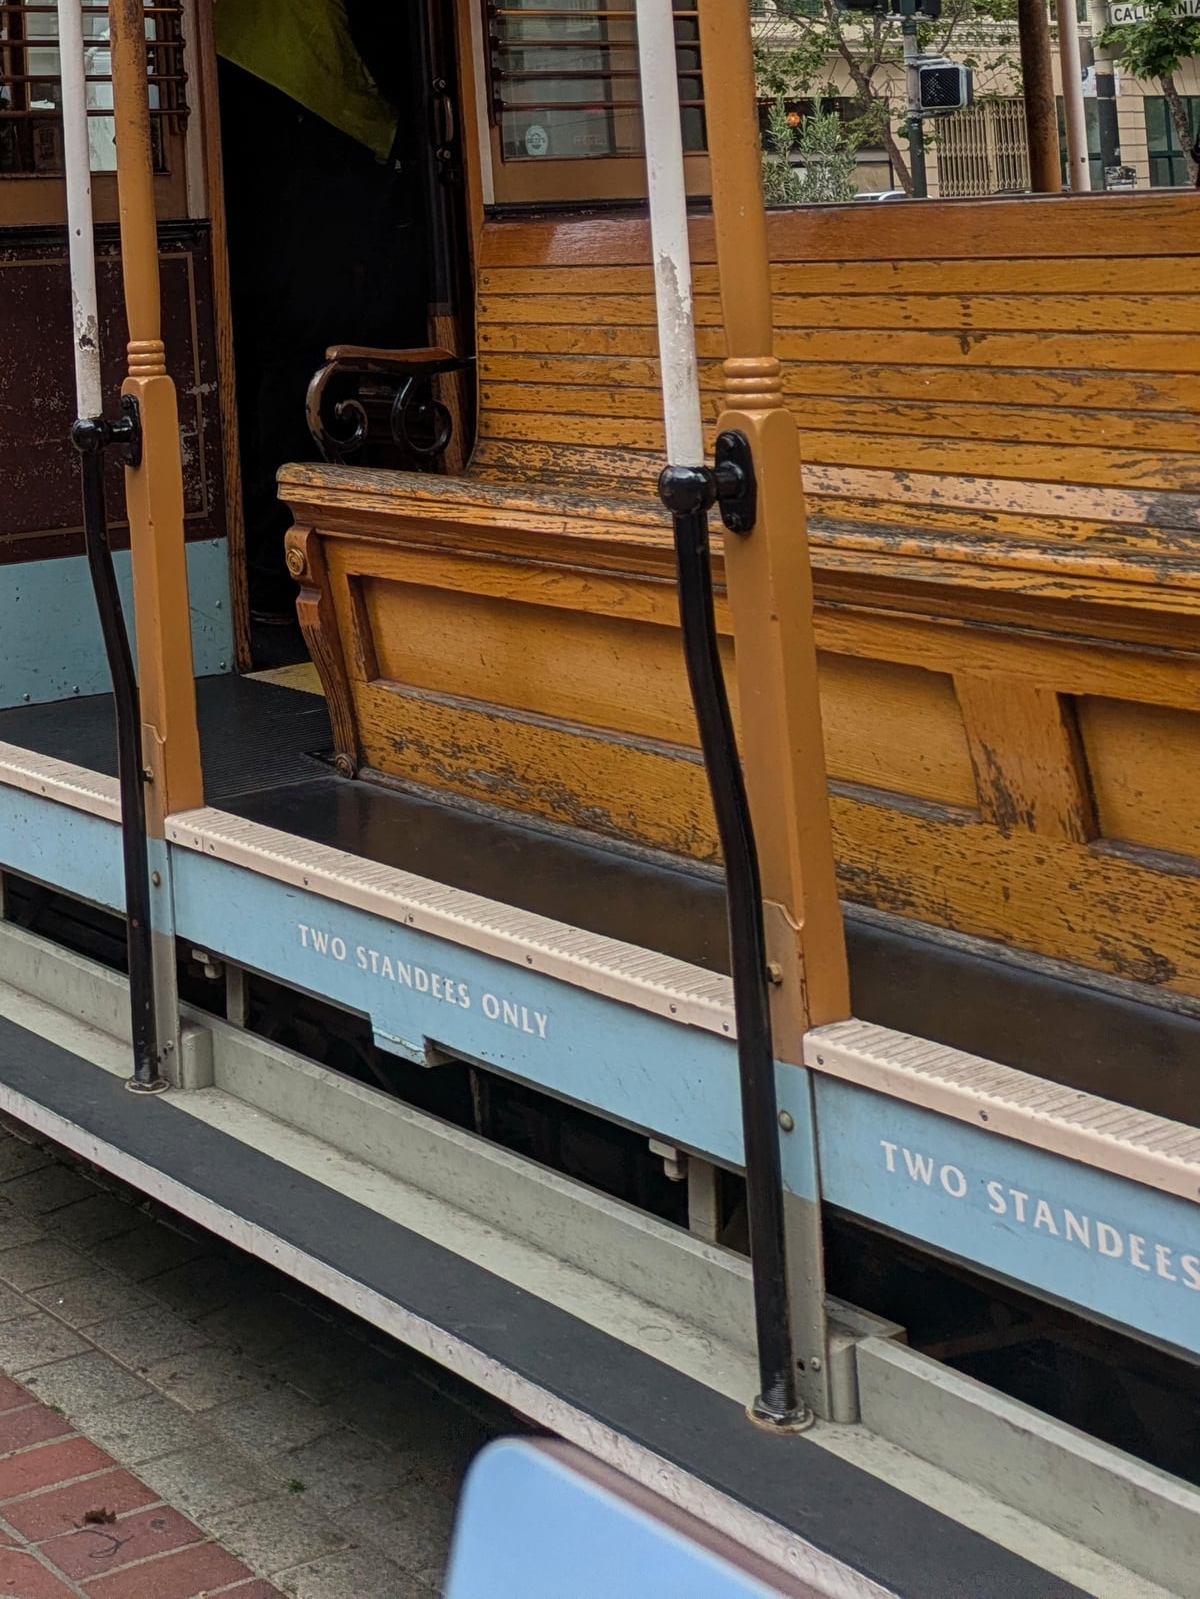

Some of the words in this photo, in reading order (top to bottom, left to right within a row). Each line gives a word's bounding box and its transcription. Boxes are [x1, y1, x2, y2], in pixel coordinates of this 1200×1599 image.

[298, 923, 347, 961] TWO
[356, 946, 470, 1009] STANDEES
[482, 993, 548, 1039] ONLY
[880, 1140, 967, 1198] TWO
[987, 1180, 1200, 1291] STANDEES
